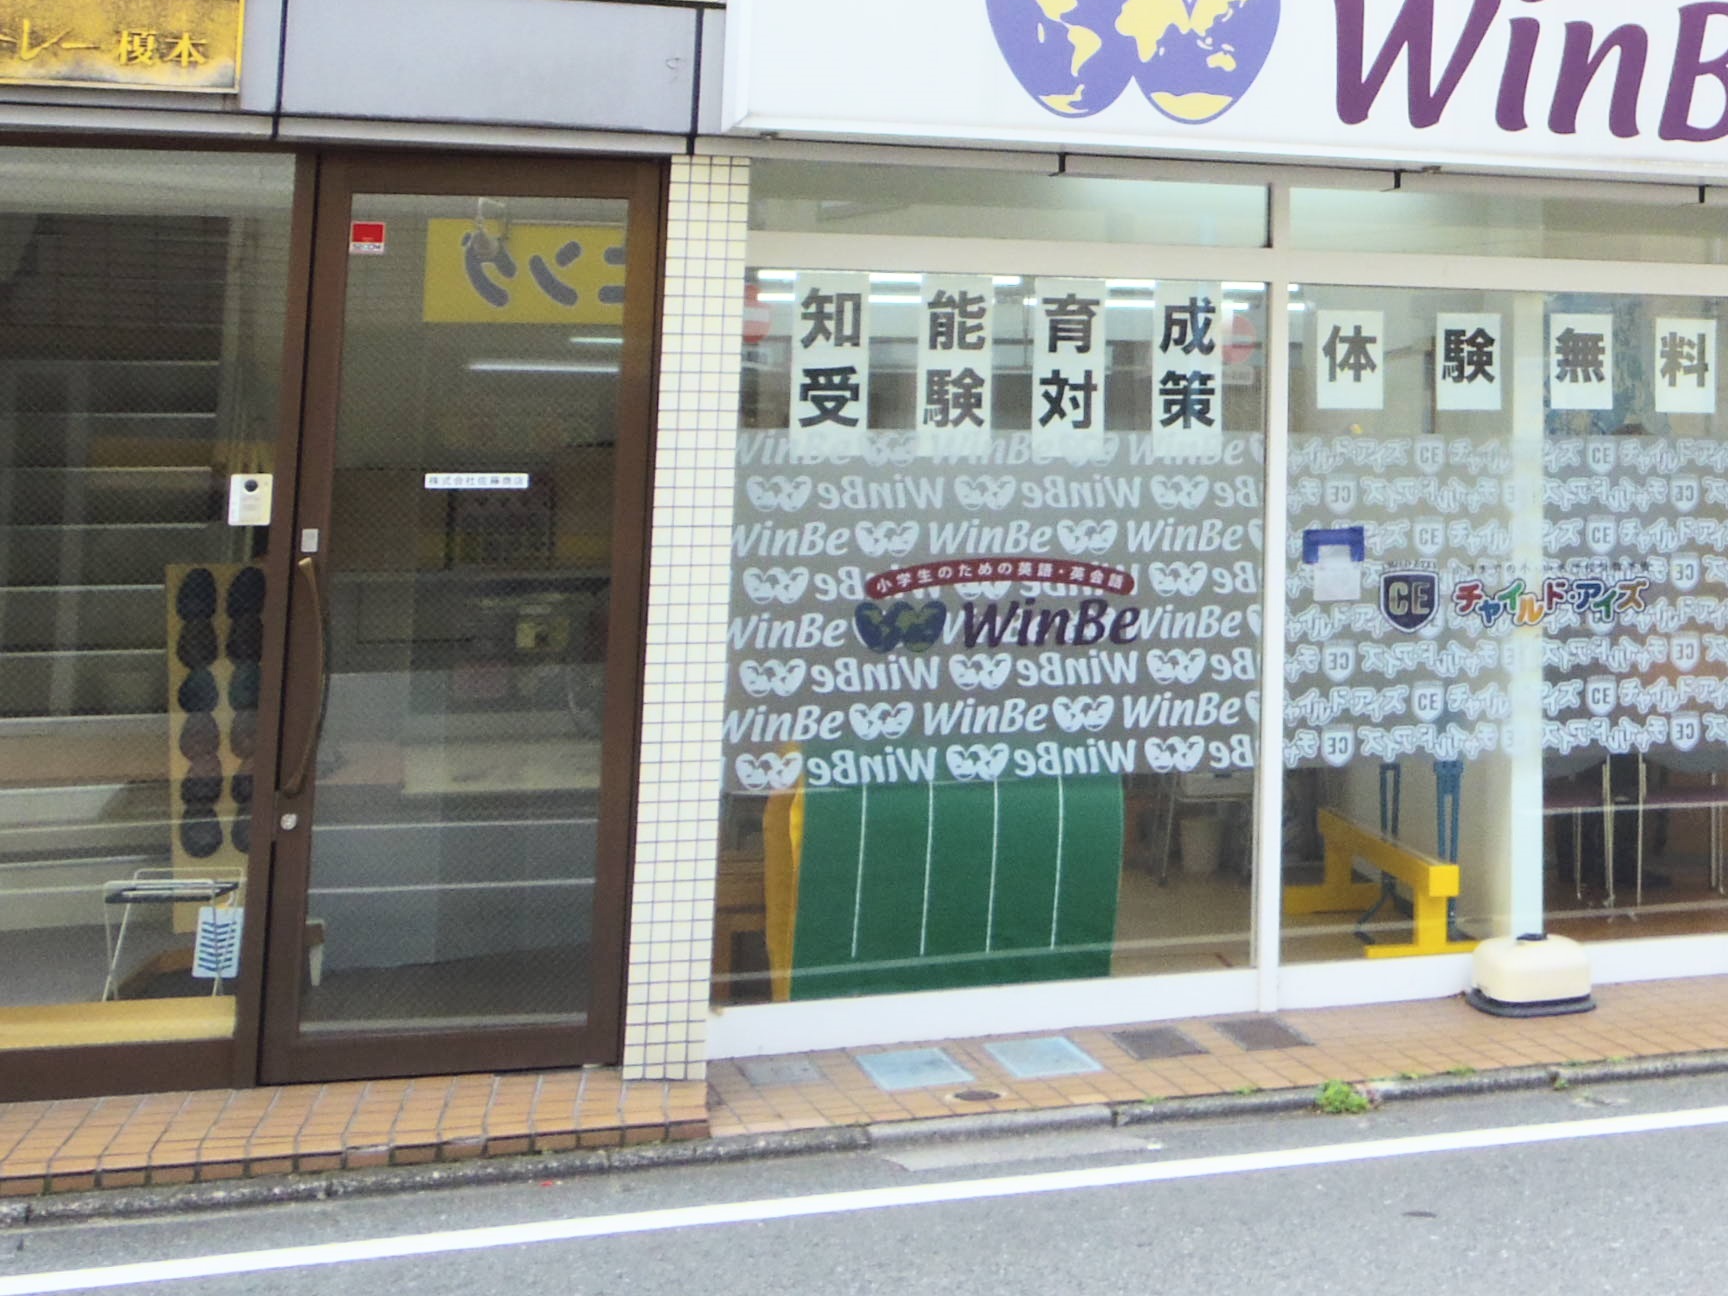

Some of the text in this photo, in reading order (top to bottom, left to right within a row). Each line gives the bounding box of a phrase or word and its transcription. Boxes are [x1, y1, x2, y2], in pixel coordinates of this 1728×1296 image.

[928, 518, 1051, 554] WinBe
[1126, 517, 1244, 552] WinBe
[876, 562, 1124, 593] 小学生のための英語・英会話
[1388, 581, 1432, 616] CE
[1453, 577, 1650, 629] チャイルド・アイズ
[963, 598, 1141, 648] WinBe
[923, 698, 1048, 736] WinBe
[1123, 691, 1241, 728] WinBe
